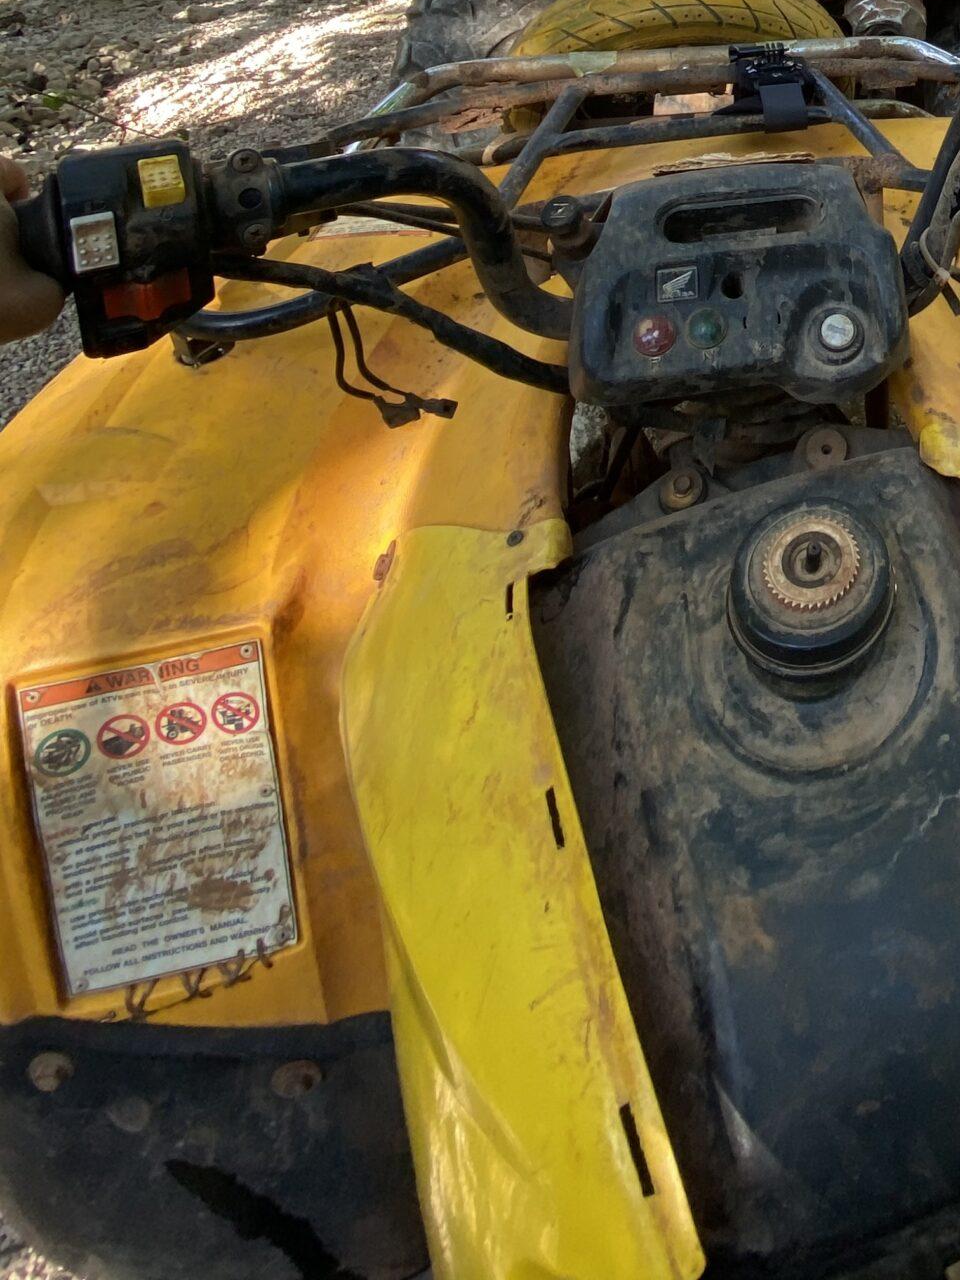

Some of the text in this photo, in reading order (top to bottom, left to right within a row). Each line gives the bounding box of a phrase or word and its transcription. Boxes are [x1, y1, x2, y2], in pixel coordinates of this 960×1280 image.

[39, 712, 73, 726] DEATH
[83, 923, 277, 976] FOLLOW ALL INSTRUCTIONS AND WARNING
[111, 943, 136, 955] READ
[142, 937, 159, 947] THE
